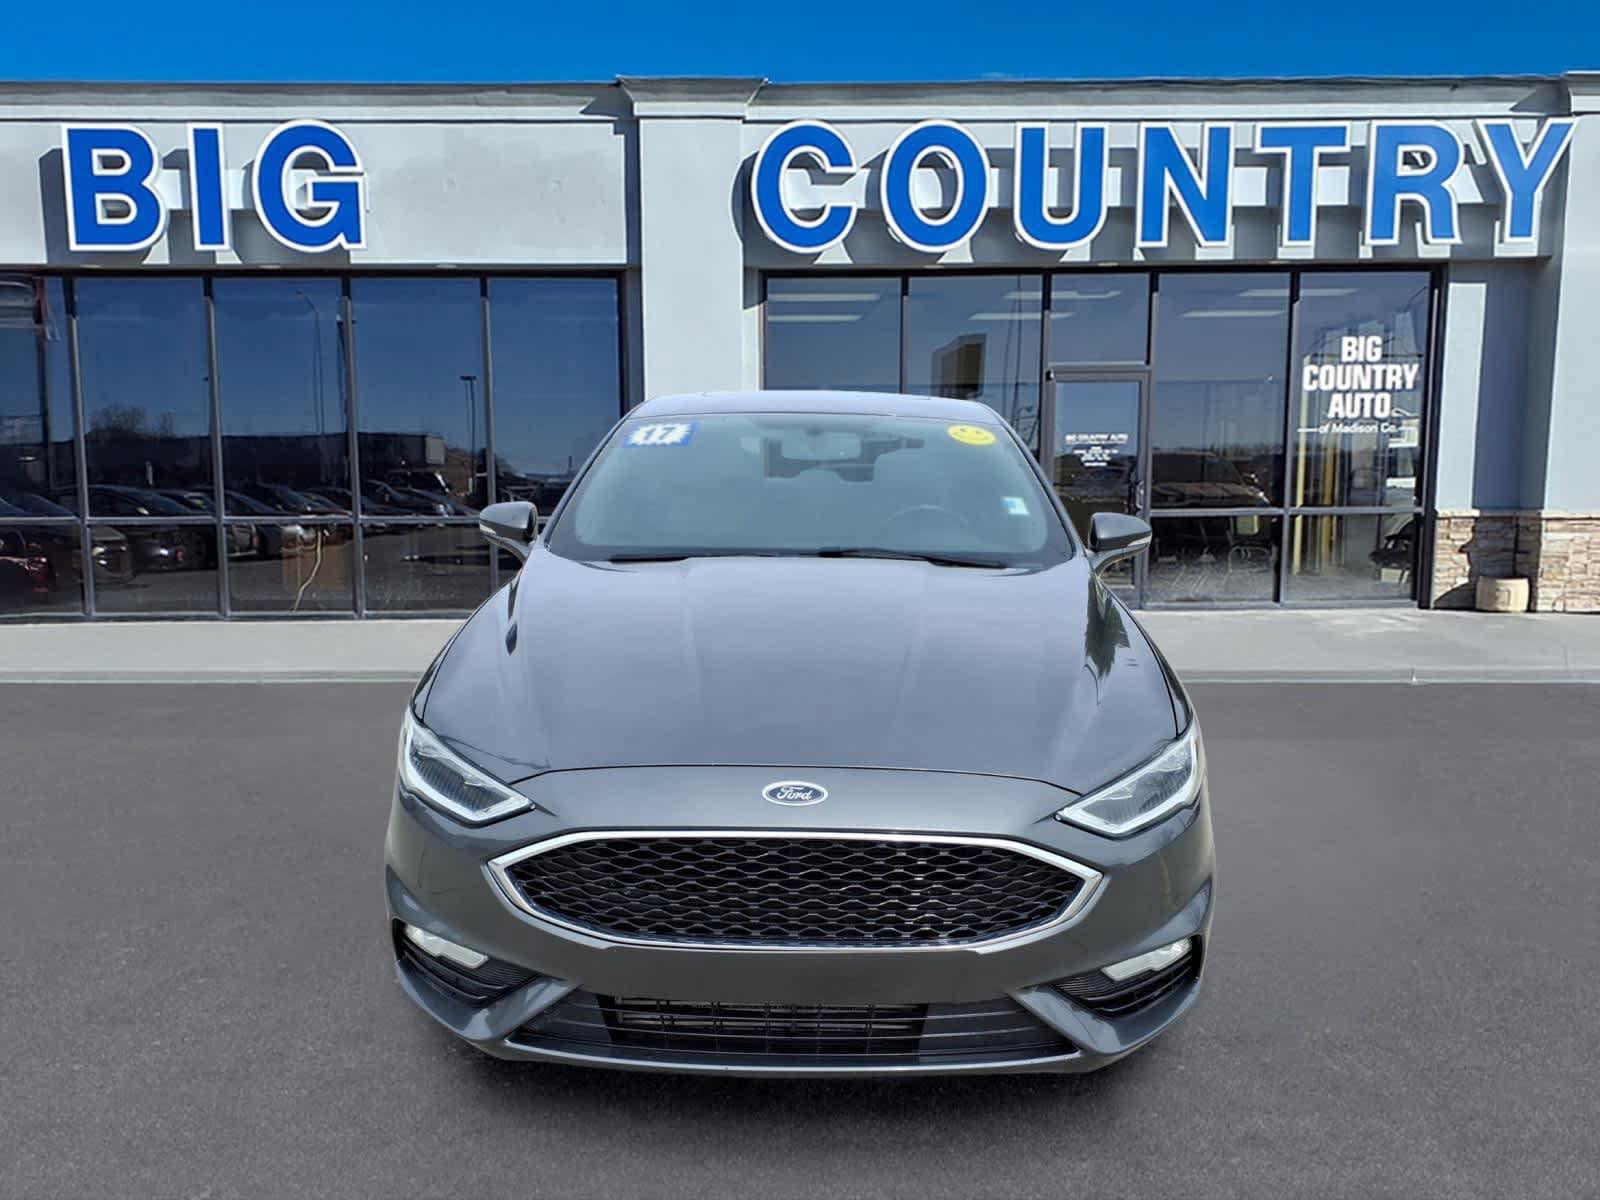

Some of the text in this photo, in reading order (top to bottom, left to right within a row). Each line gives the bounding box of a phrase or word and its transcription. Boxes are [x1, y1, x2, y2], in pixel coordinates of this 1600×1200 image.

[61, 118, 1576, 255] BIG COUNTRY
[1341, 335, 1382, 362] BIG
[1302, 363, 1419, 391] COUNTRY
[1328, 392, 1391, 419] AUTO
[1319, 422, 1329, 433] of
[1331, 422, 1379, 433] Madison
[776, 786, 813, 800] Ford
